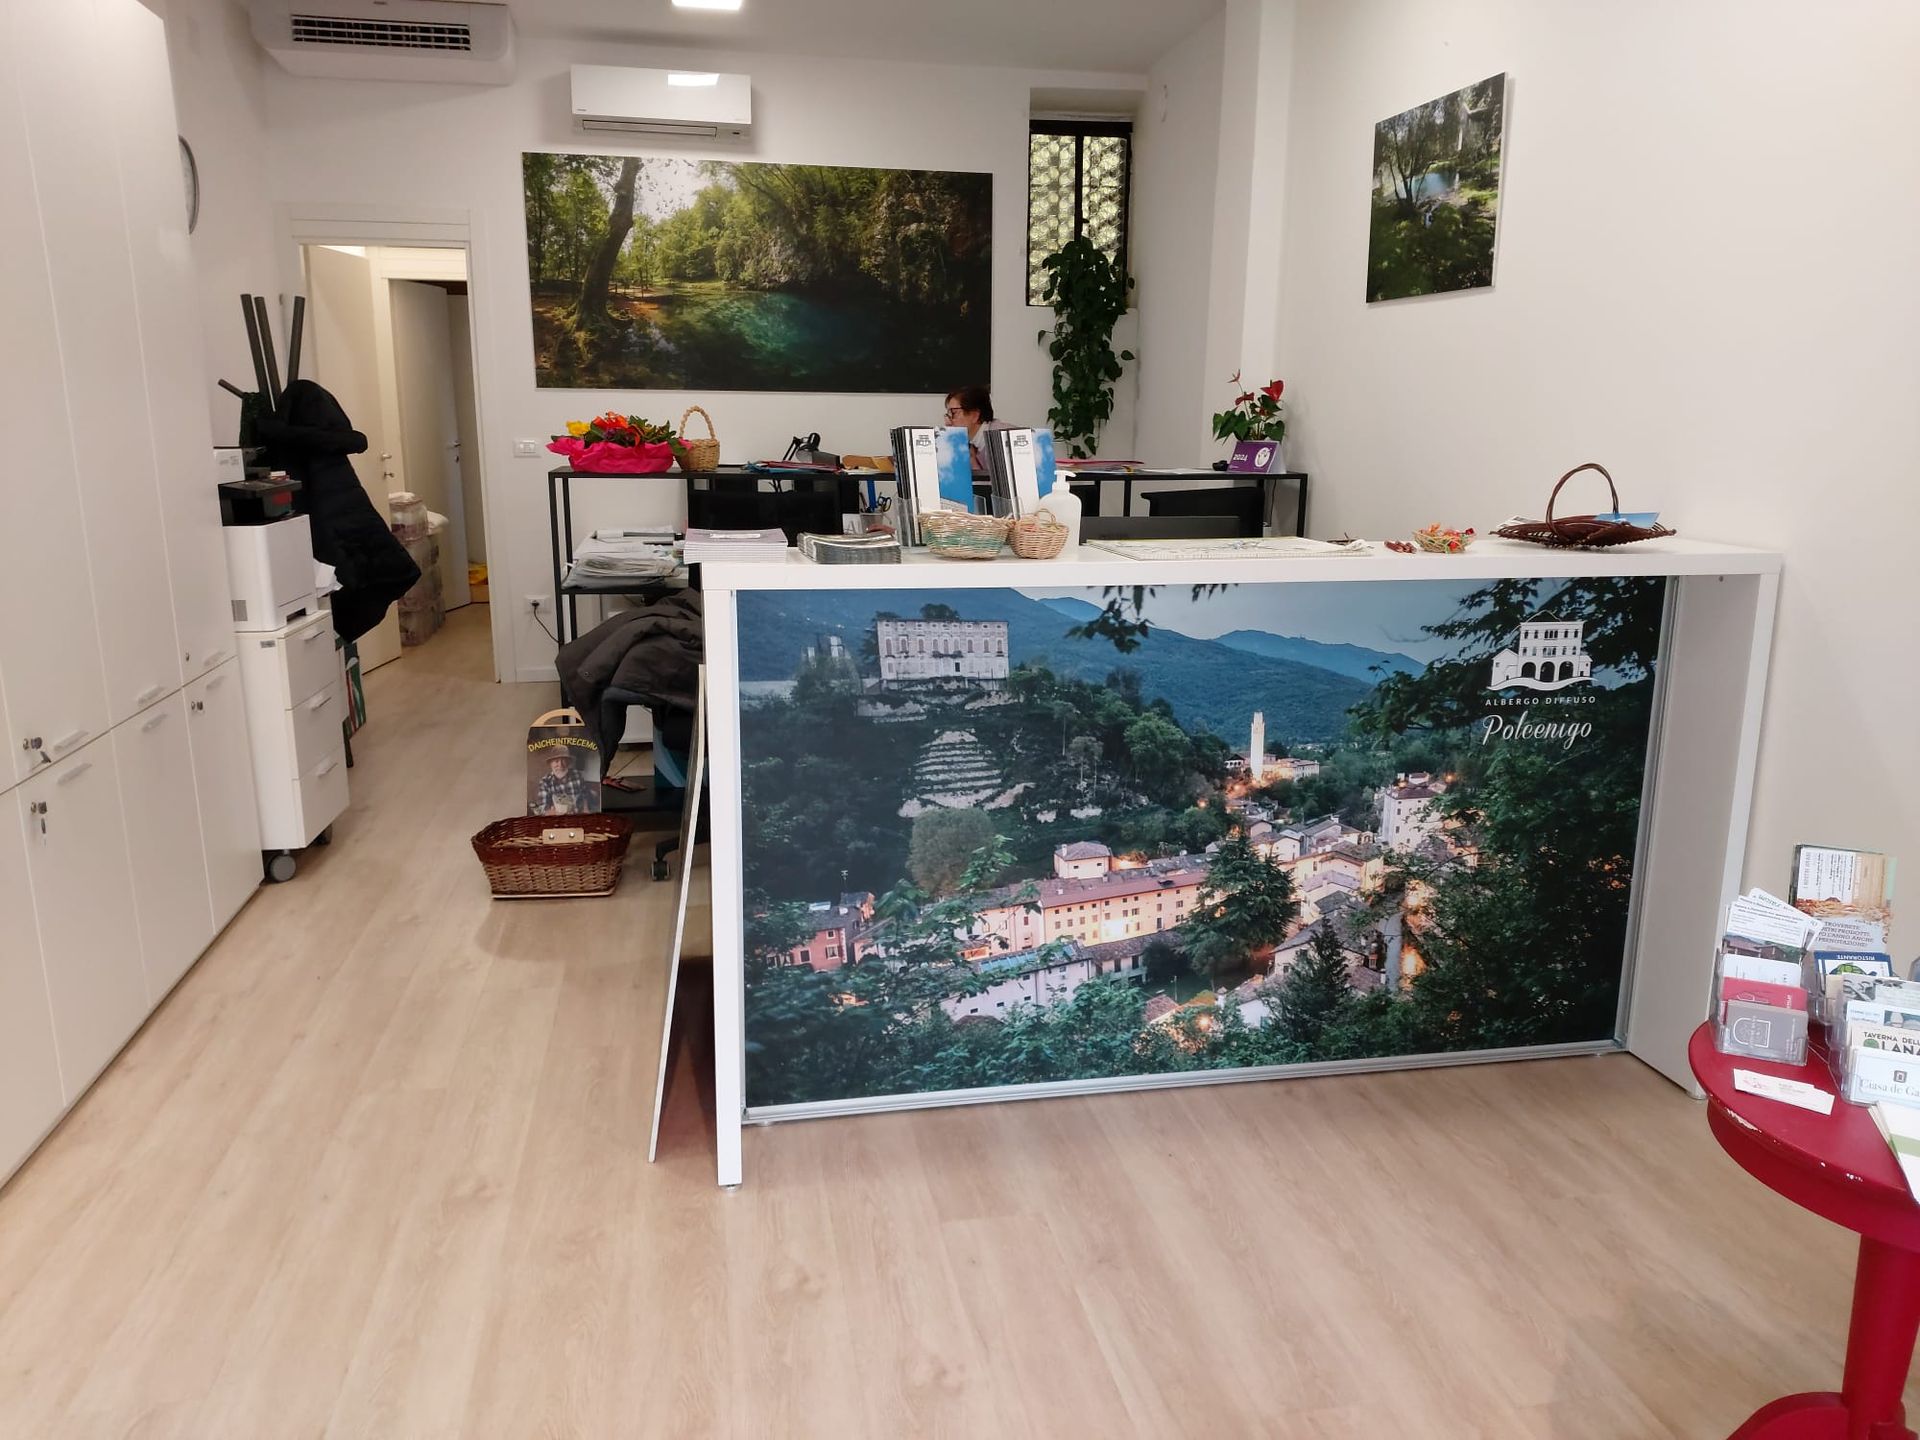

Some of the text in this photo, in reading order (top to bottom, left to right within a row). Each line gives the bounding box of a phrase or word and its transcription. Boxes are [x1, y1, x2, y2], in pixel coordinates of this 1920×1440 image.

[1485, 696, 1597, 706] ALBERGO DIFFUSO
[1482, 710, 1593, 750] Polcenigo
[1863, 1031, 1898, 1043] TAVERNA
